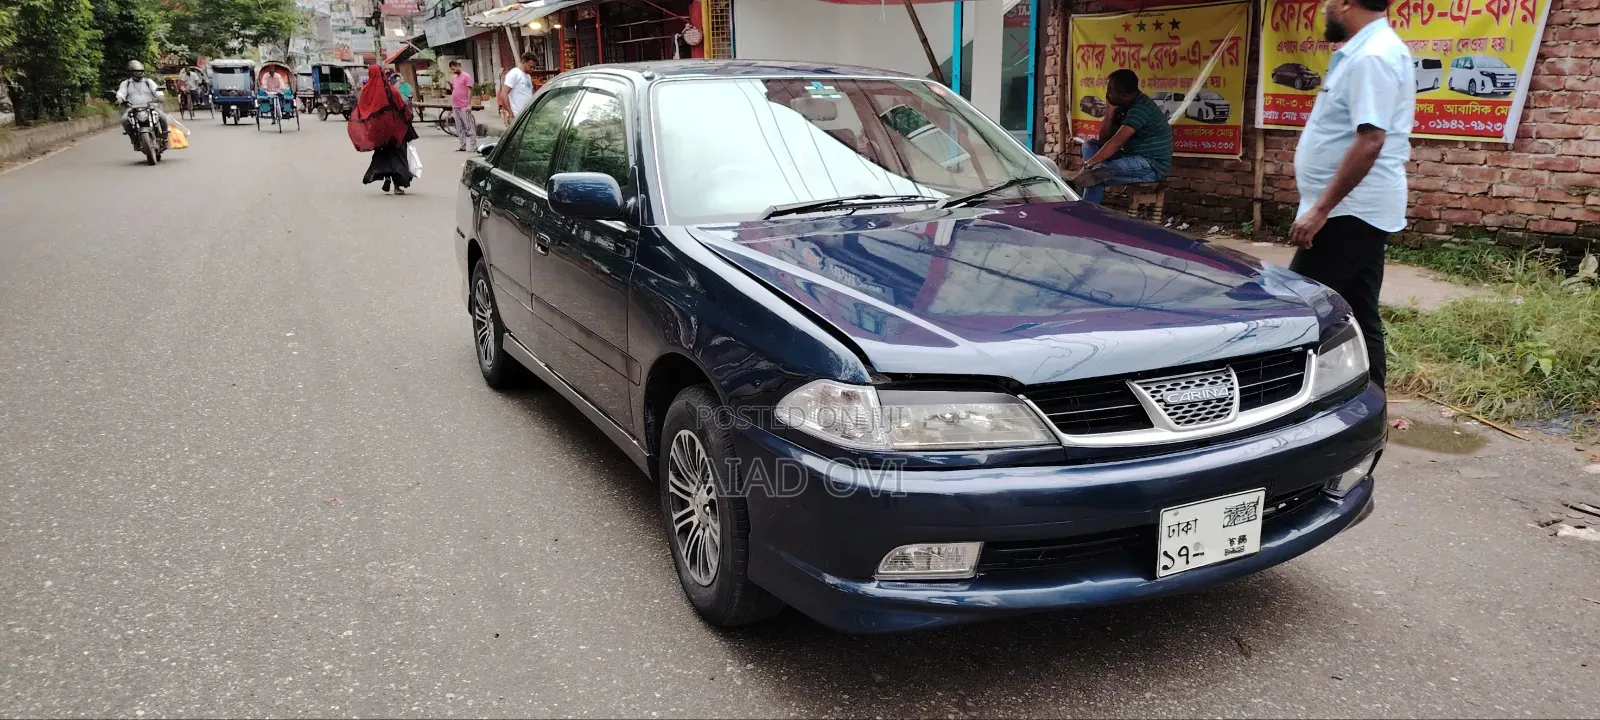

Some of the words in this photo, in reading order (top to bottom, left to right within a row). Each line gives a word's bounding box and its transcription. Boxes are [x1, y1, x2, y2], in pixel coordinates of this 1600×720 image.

[1076, 42, 1106, 71] ফোর
[1443, 102, 1492, 115] আবাসিক
[1495, 105, 1511, 116] মো
[1167, 386, 1229, 403] CARINA
[1167, 517, 1198, 539] ঢাকা
